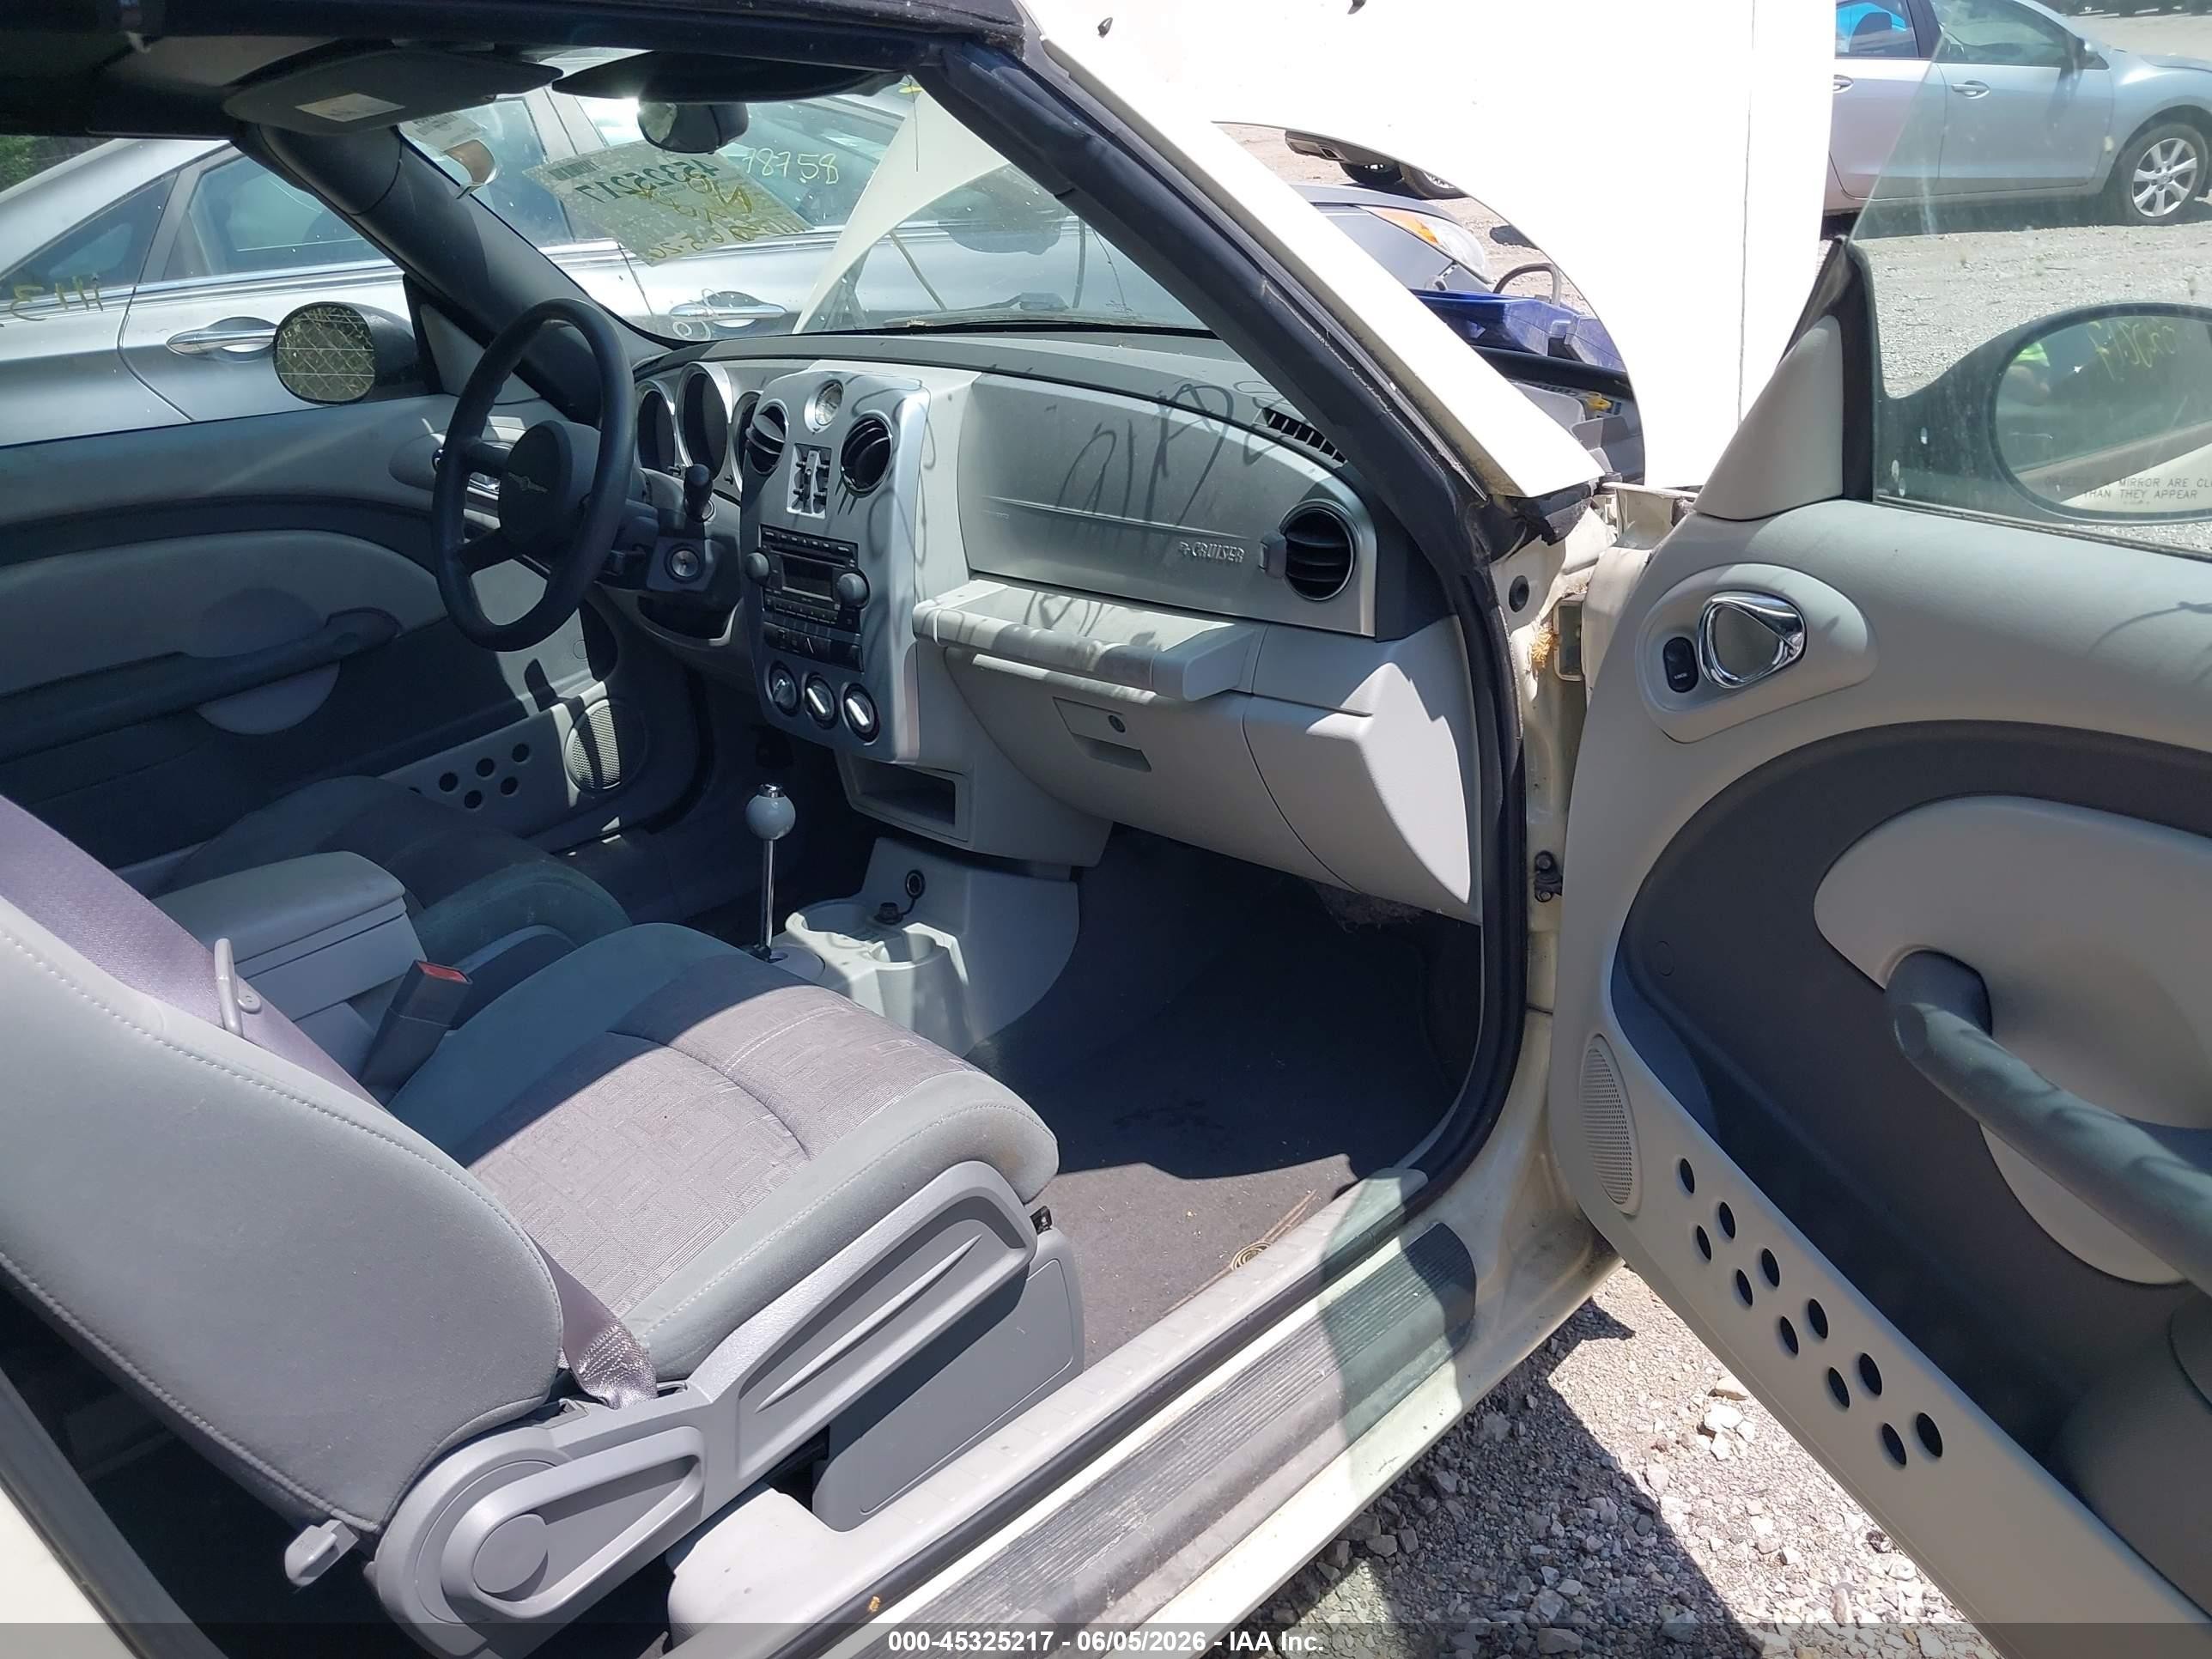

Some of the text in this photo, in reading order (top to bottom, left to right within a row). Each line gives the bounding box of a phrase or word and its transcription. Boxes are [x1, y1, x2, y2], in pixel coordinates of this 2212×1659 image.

[2118, 477, 2160, 488] MIRROR
[2167, 477, 2189, 488] ARE
[2120, 489, 2148, 499] THEY
[2154, 489, 2198, 500] APPEAR
